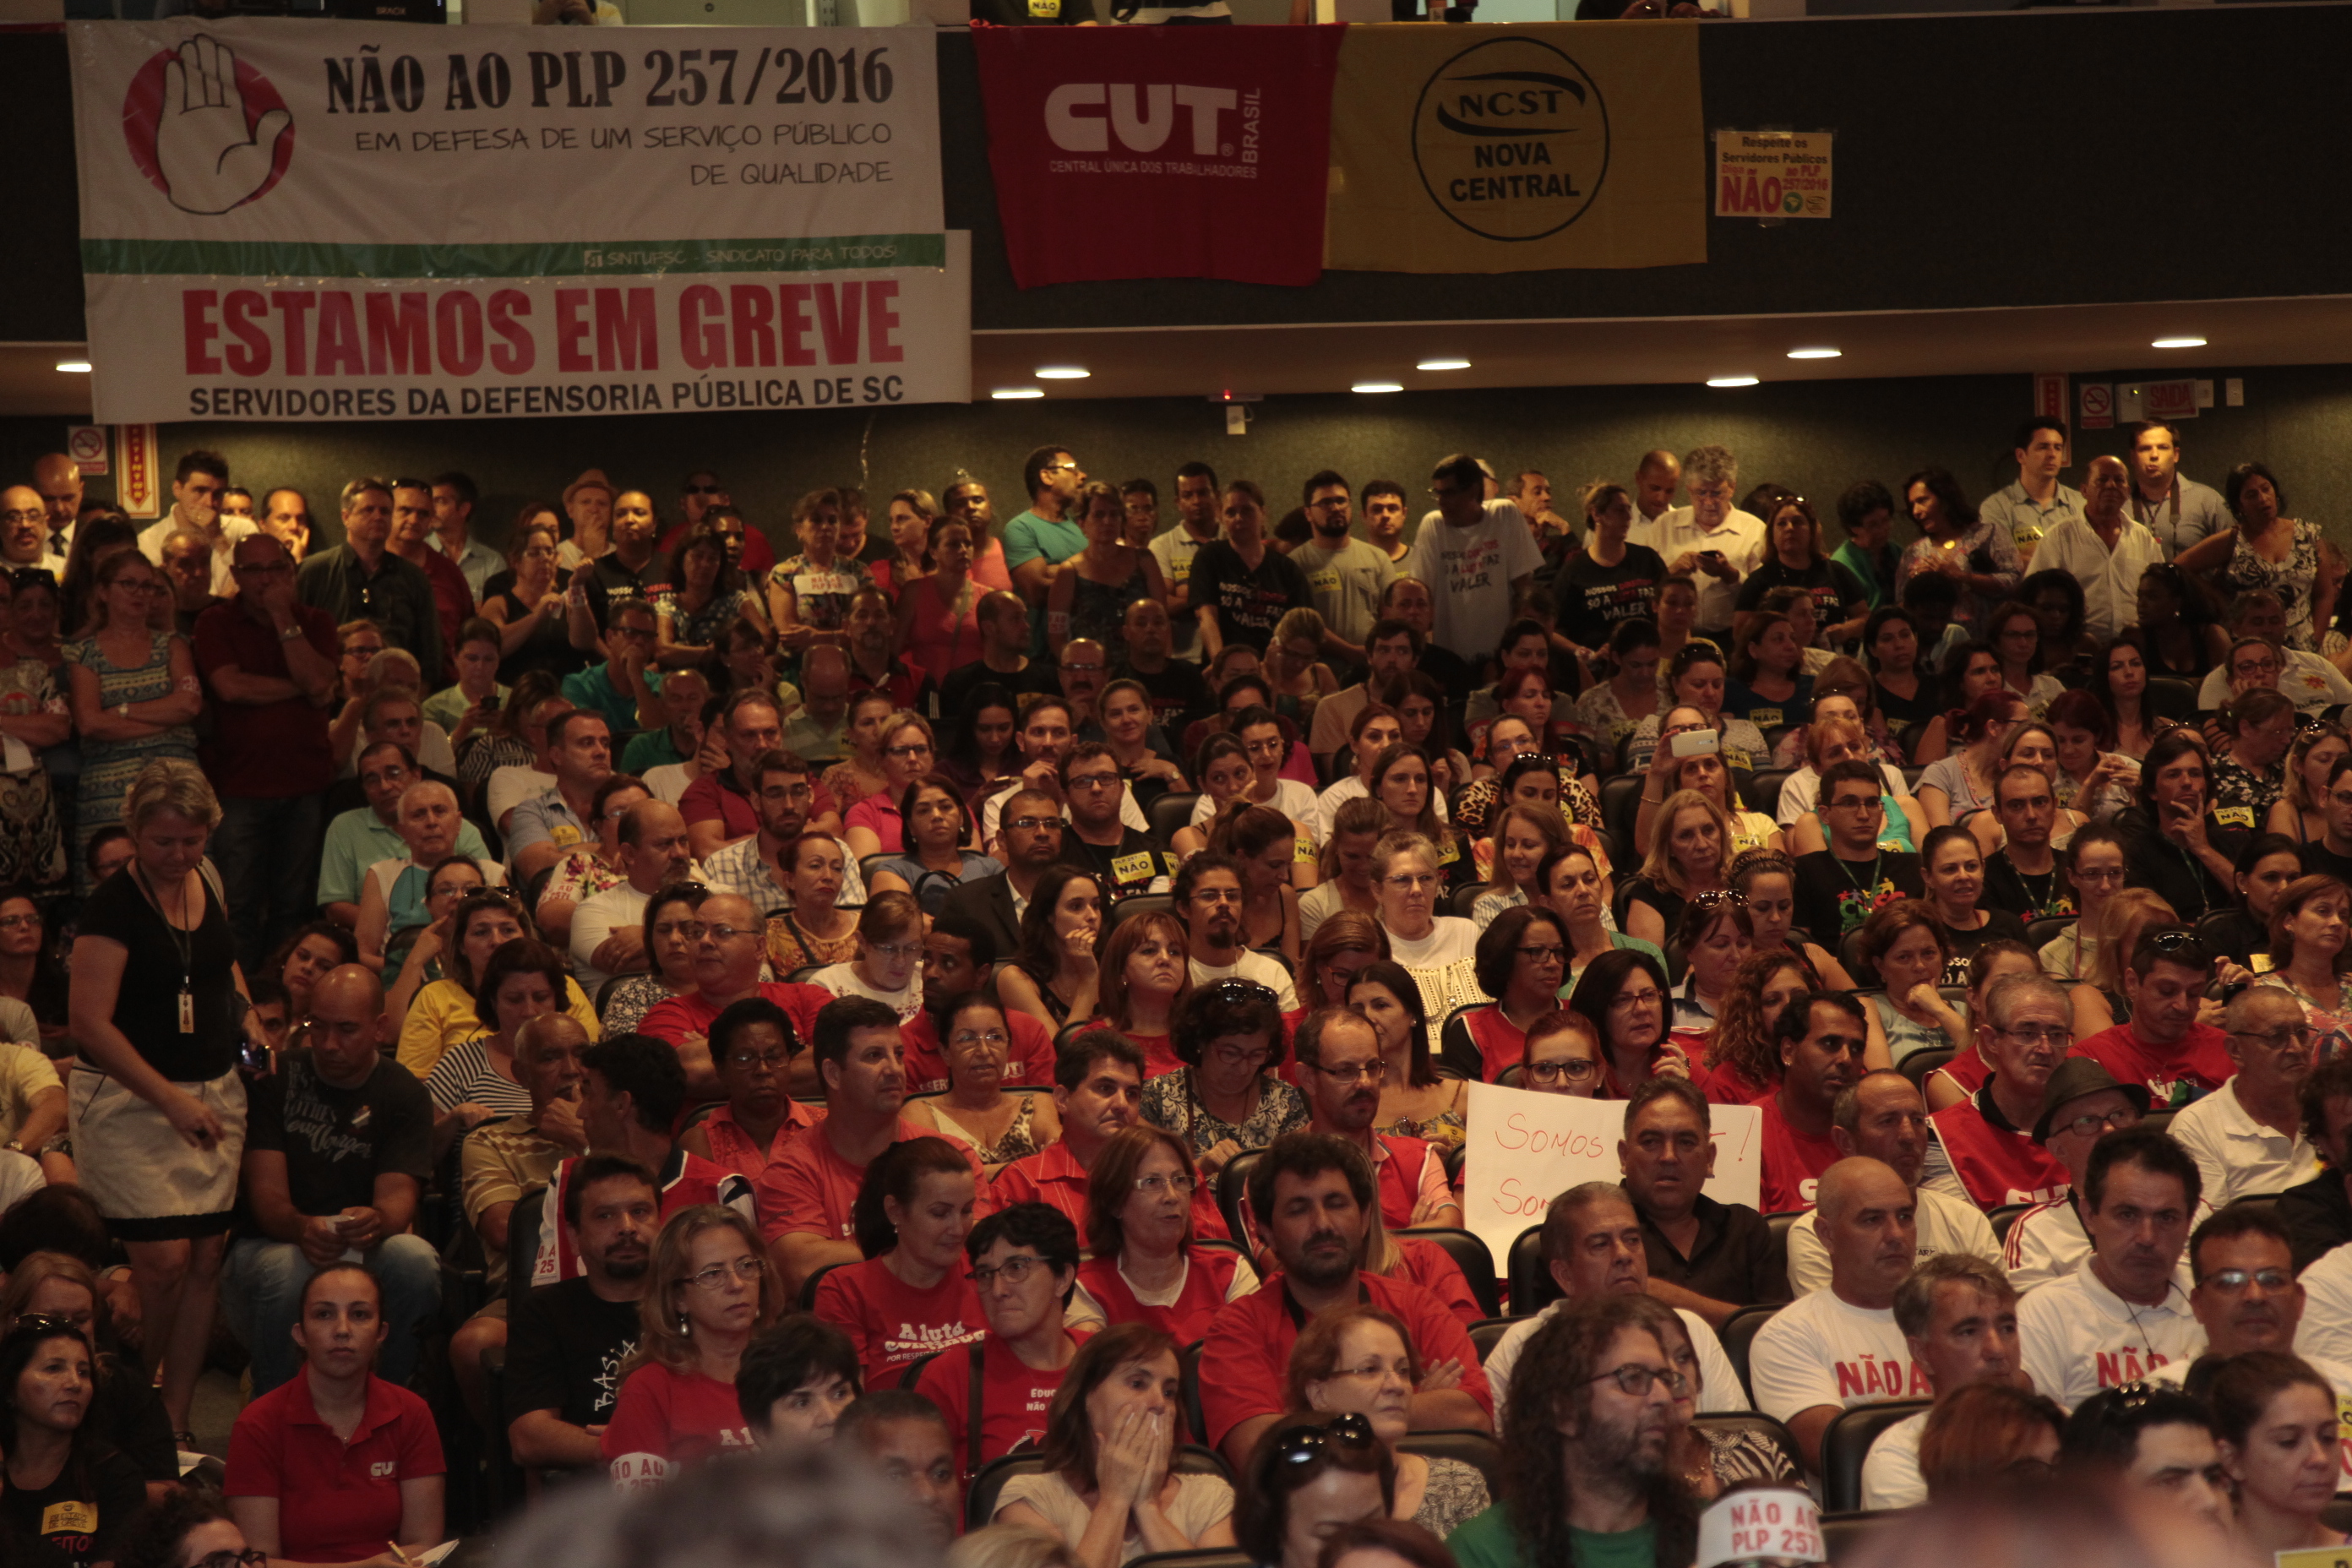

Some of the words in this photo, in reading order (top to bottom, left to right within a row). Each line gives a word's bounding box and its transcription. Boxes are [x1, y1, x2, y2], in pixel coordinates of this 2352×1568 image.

[324, 44, 425, 113] NÃO
[444, 52, 511, 111] AO
[527, 50, 627, 107] PLP
[644, 46, 894, 107] 257/2016
[1459, 90, 1564, 117] NCST
[1044, 83, 1238, 155] CUT
[1242, 87, 1261, 163] BRASIL
[356, 131, 401, 152] EM
[412, 128, 530, 151] DEFESA
[542, 128, 579, 150] DE
[591, 127, 632, 150] UM
[644, 124, 761, 153] SERVIÇO
[774, 121, 891, 145] PÚBLICO
[1474, 142, 1551, 168] NOVA
[1722, 153, 1779, 163] Servidores
[690, 164, 728, 186] DE
[741, 161, 893, 185] QUALIDADE
[1049, 160, 1102, 173] CENTRAL
[1104, 158, 1139, 173] ÚNICA
[1141, 161, 1162, 174] DOS
[1164, 161, 1257, 179] TRABALHADORES
[1449, 173, 1580, 202] CENTRAL
[1722, 168, 1782, 213] NÃO
[706, 248, 786, 264] SINDICATO
[792, 248, 834, 262] PARA
[182, 289, 536, 376] ESTAMOS
[555, 287, 658, 372] EM
[678, 280, 904, 370] GREVE
[189, 387, 396, 416] SERVIDORES
[408, 388, 450, 415] DA
[461, 383, 662, 413] DEFENSORIA
[672, 373, 804, 409] PÚBLICA
[814, 377, 853, 405] DE
[863, 375, 904, 402] SC
[1451, 573, 1490, 592] VALER
[1602, 602, 1648, 621] VALER
[1298, 847, 1315, 856] NÃ
[1119, 860, 1149, 874] NÃO
[1437, 885, 1451, 900] AZ
[1495, 1113, 1603, 1158] SOMOS
[898, 1323, 917, 1341] A
[886, 1353, 901, 1363] POR
[1834, 1353, 1903, 1398] NÃO
[1908, 1361, 1932, 1396] A
[1026, 1402, 1046, 1412] NÃO
[1731, 1499, 1781, 1527] NÃO
[1732, 1529, 1770, 1555] PLP
